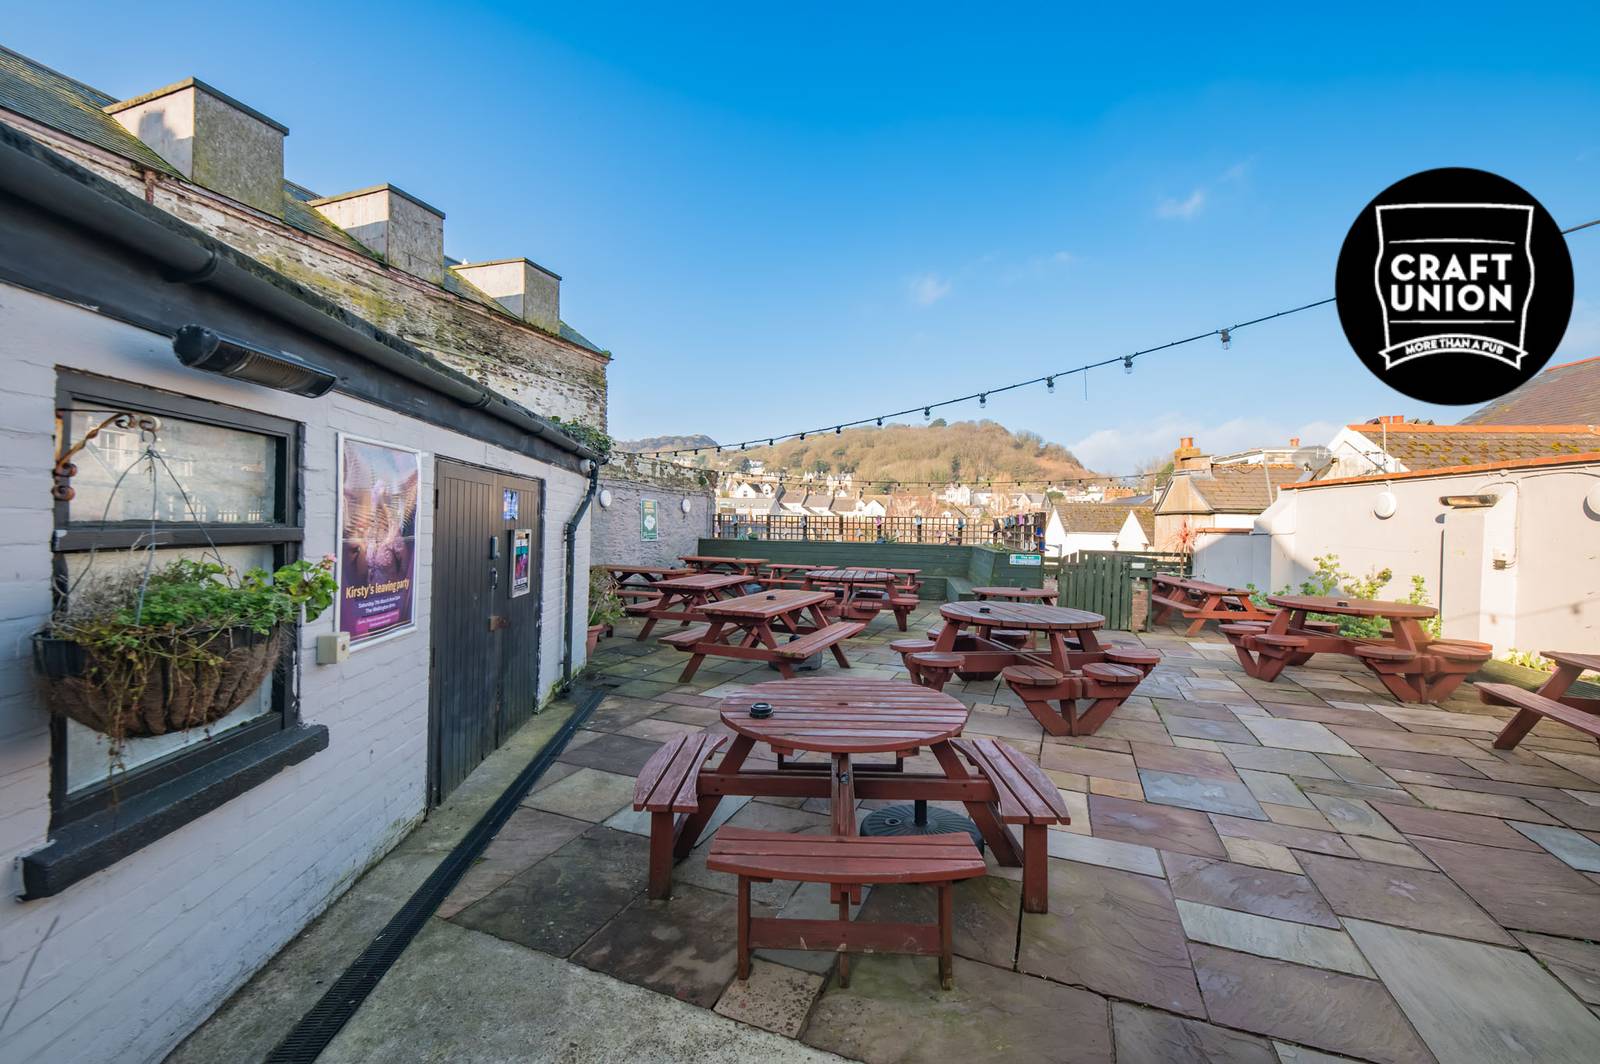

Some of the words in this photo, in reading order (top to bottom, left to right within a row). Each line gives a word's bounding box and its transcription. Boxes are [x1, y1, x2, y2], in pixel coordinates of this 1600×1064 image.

[346, 584, 374, 599] Kirsty's
[375, 580, 396, 593] leaving
[397, 578, 410, 592] party
